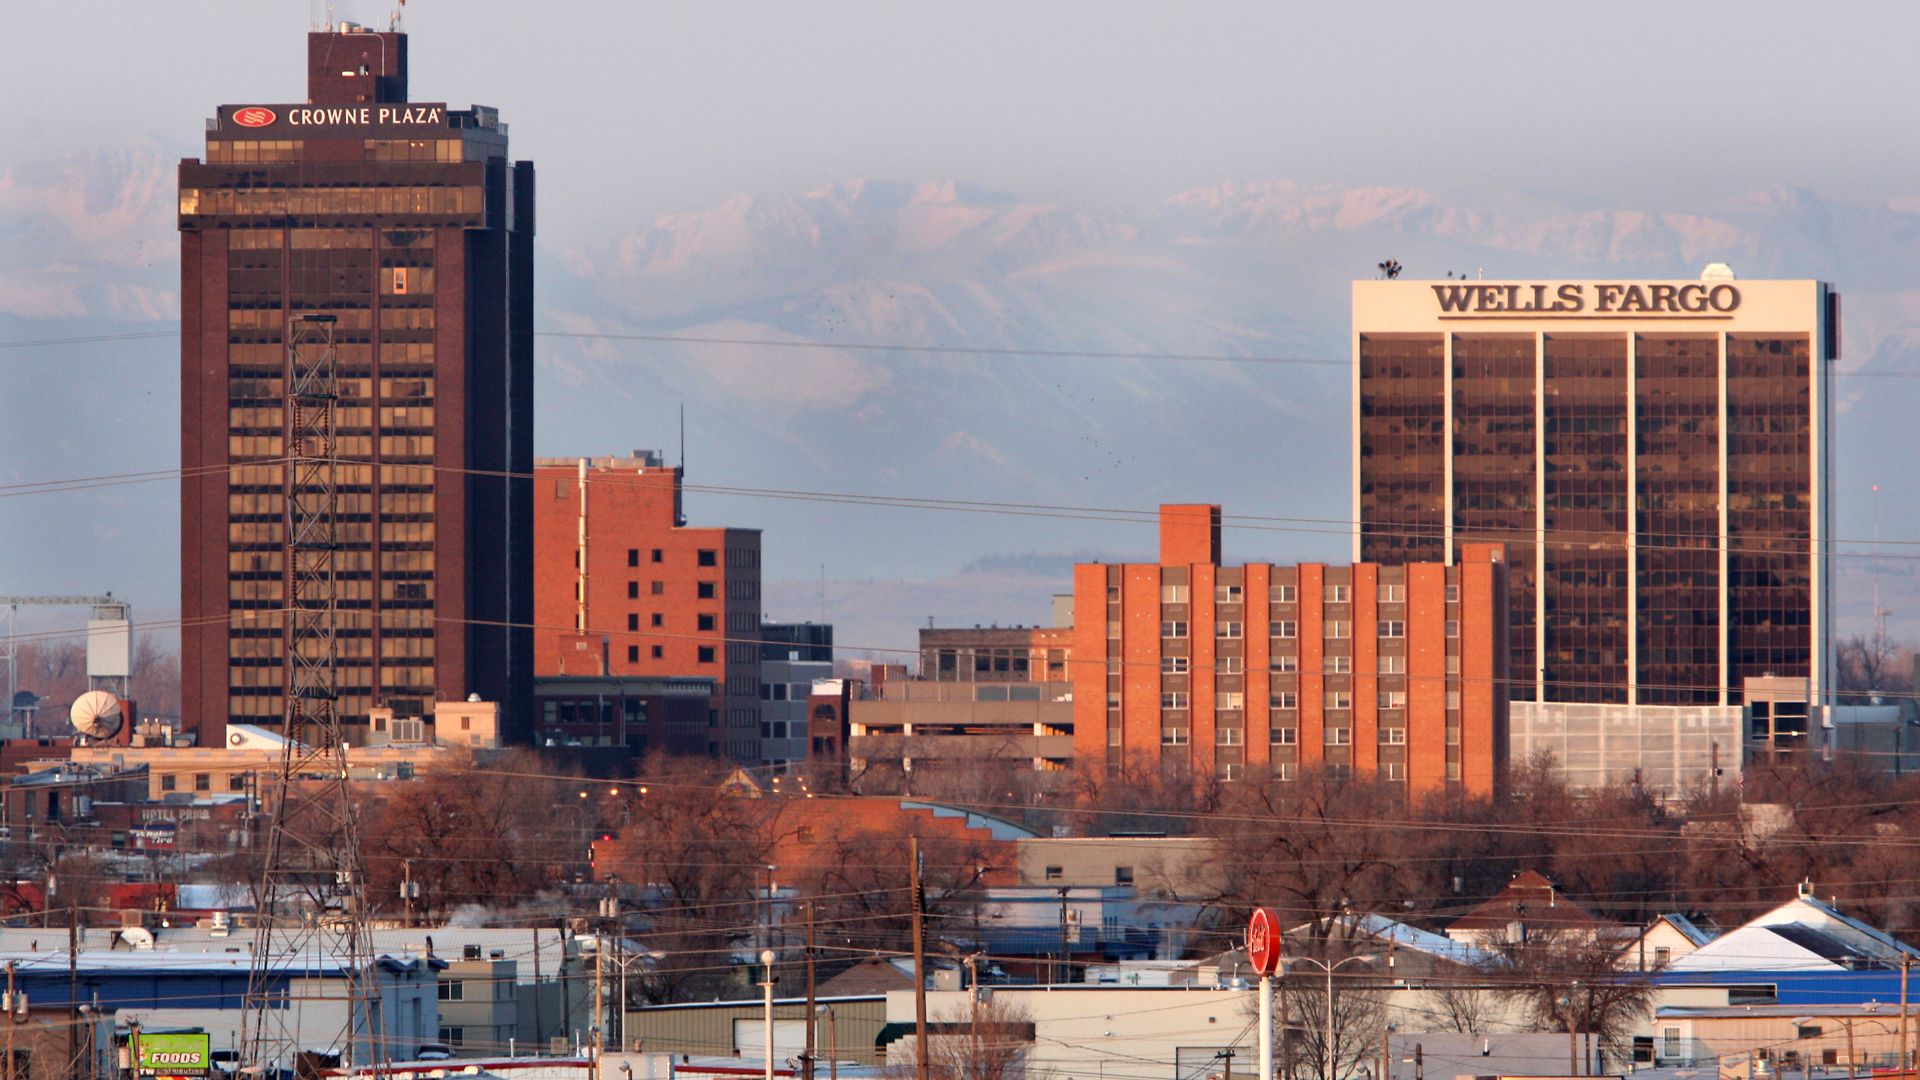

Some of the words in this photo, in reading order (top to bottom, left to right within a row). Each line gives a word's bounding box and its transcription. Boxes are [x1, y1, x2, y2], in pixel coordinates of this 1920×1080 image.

[288, 108, 370, 125] CROWNE
[379, 107, 440, 125] PLAZA
[1431, 284, 1584, 313] WELLS
[1594, 284, 1741, 313] FARGO
[142, 808, 176, 820] HOTEL
[151, 1052, 201, 1064] FOODS
